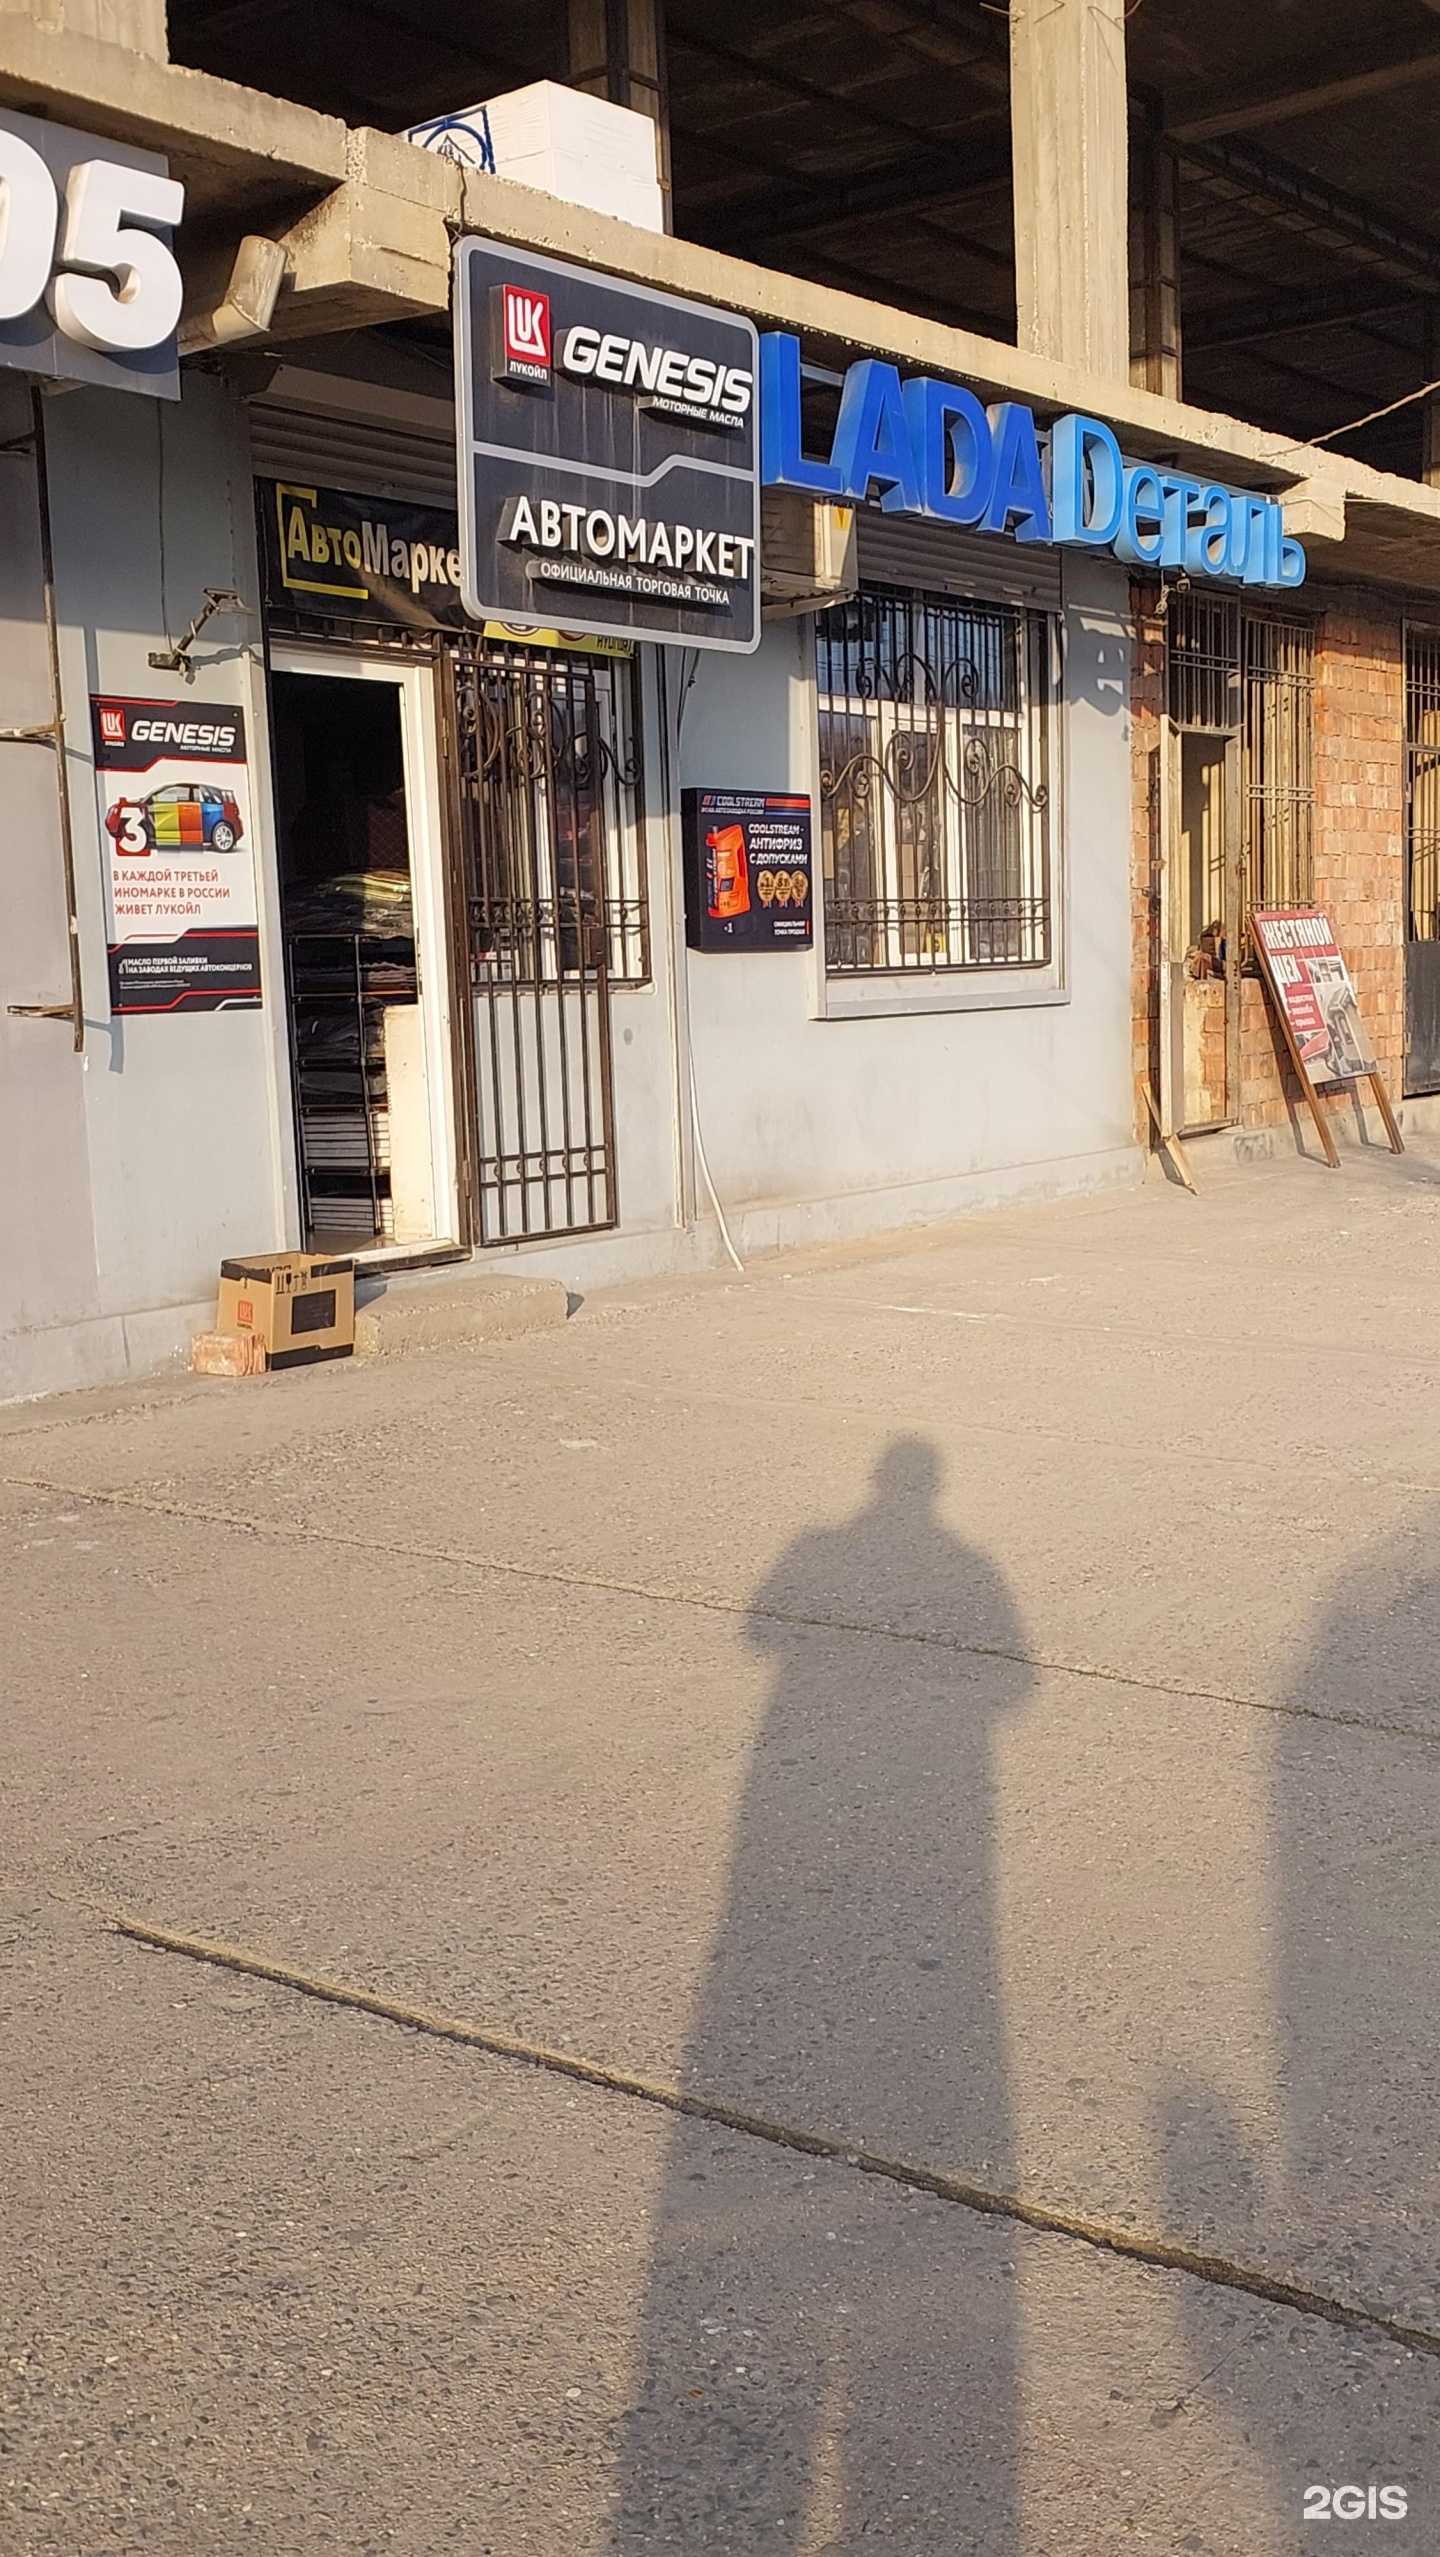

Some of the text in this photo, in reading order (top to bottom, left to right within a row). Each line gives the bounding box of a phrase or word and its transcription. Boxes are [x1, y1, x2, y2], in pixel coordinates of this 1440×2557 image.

[509, 361, 548, 380] ЛУКОЙЛ
[562, 325, 754, 413] GENESIS
[652, 397, 745, 428] МОТОРНЫЕ МАСЛА
[761, 331, 1053, 545] LADA
[509, 495, 755, 579] АВТОМАРКЕТ
[540, 562, 730, 605] ОФИЦИАЛЬНАЯ ТОРГОВАЯ ТОЧКА
[131, 719, 237, 747] GENESIS
[119, 807, 148, 853] 3
[748, 823, 800, 835] COOLSTREAM
[749, 837, 803, 851] АНТИФРИЗ
[749, 853, 808, 866] С ДОПУСКАМИ
[113, 868, 219, 883] В КАЖДОЙ ТРЕТЬЕЙ
[114, 887, 231, 898] ИНОМАРКЕ В РОССИИ
[115, 901, 201, 915] ЖИВЕТ ЛУКОЙЛ
[1260, 915, 1335, 949] ЖЕСТЯНОЙ
[1270, 953, 1303, 986] ЦЕХ
